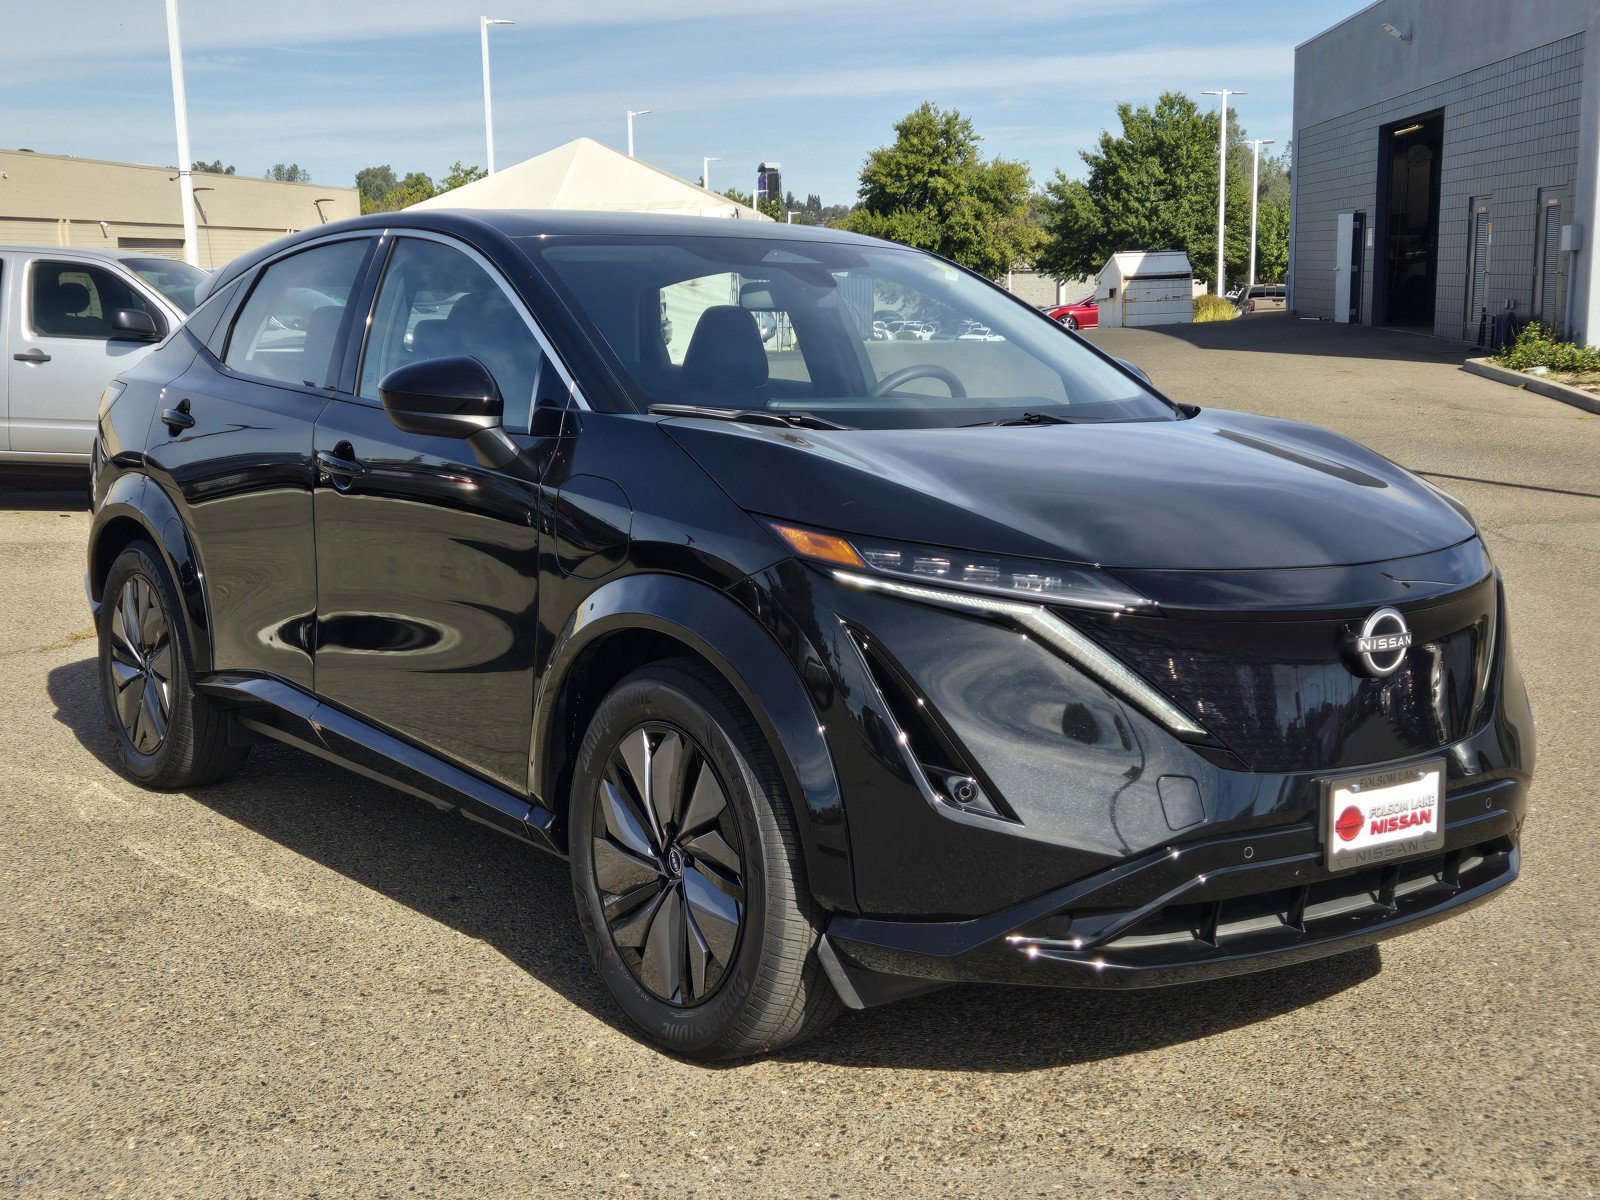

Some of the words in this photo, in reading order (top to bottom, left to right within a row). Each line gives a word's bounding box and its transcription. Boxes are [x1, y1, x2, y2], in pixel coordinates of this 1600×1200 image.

[1360, 634, 1412, 651] NISSAN
[1361, 773, 1396, 788] FOLSOM
[1397, 769, 1420, 782] LAKE
[1370, 801, 1409, 818] FOLSOM
[1411, 794, 1435, 810] LAKE
[1370, 809, 1432, 836] NISSAN
[1356, 841, 1418, 862] NISSAN
